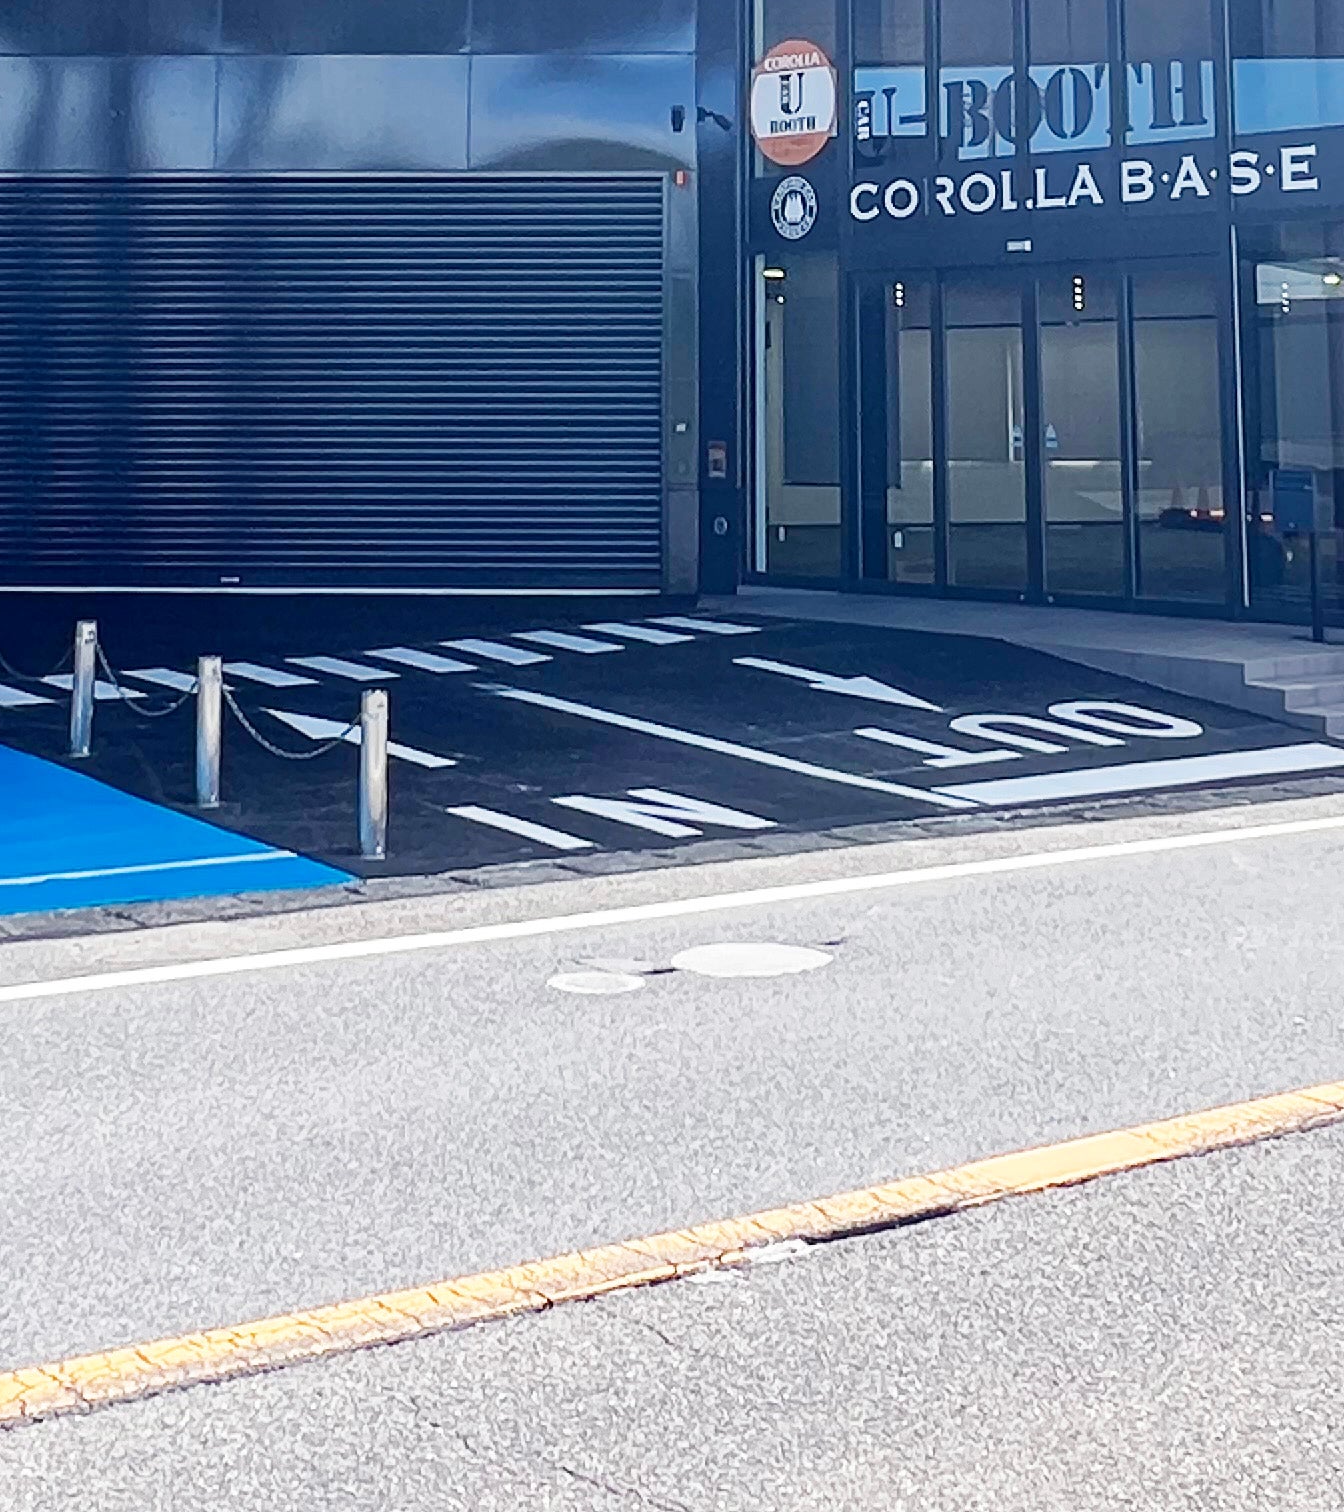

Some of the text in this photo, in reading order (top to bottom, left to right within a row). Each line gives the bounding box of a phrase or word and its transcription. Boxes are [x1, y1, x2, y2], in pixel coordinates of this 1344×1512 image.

[764, 51, 820, 71] COROLLA
[770, 115, 816, 134] BOOTH
[850, 163, 1104, 220] COROLLA
[856, 699, 1203, 769] OUT
[447, 788, 778, 850] IN
